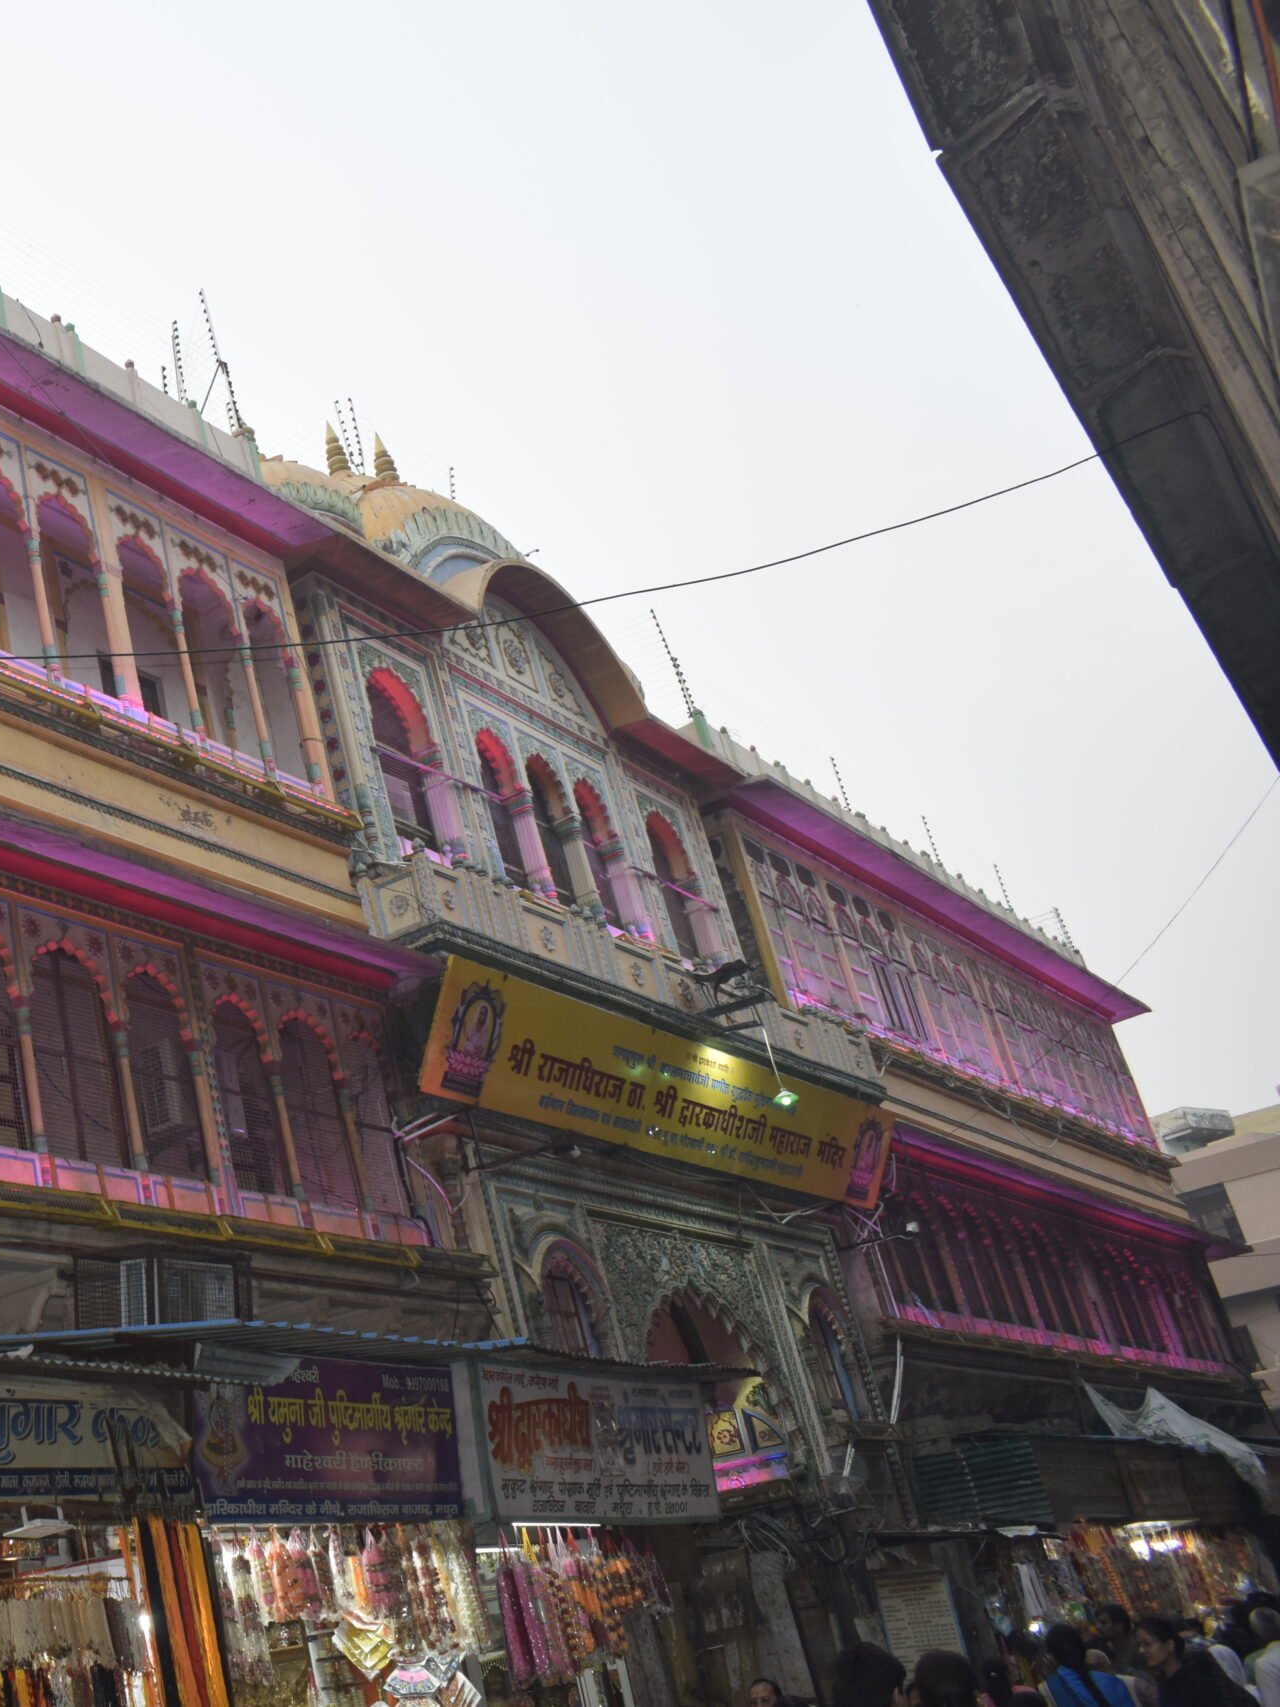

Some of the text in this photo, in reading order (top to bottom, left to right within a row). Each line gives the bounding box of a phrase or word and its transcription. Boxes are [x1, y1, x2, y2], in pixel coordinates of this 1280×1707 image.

[508, 1038, 535, 1077] श्री
[537, 1053, 625, 1104] राजाधिराज
[627, 1081, 647, 1111] ठा.
[653, 1085, 679, 1119] श्री
[678, 1097, 767, 1145] द्वारकाधीशजी
[769, 1125, 814, 1158] महाराज
[817, 1133, 848, 1169] मंदिर
[247, 1386, 265, 1425] श्री
[267, 1396, 305, 1444] यमुना
[307, 1387, 326, 1428] जी
[327, 1389, 392, 1445] पुष्टिमार्गीय
[426, 1398, 453, 1439] केन्द्र
[488, 1385, 513, 1471] श्री
[283, 1449, 347, 1471] माहेश्वरी
[269, 1498, 304, 1517] मन्दिर
[305, 1500, 317, 1516] के
